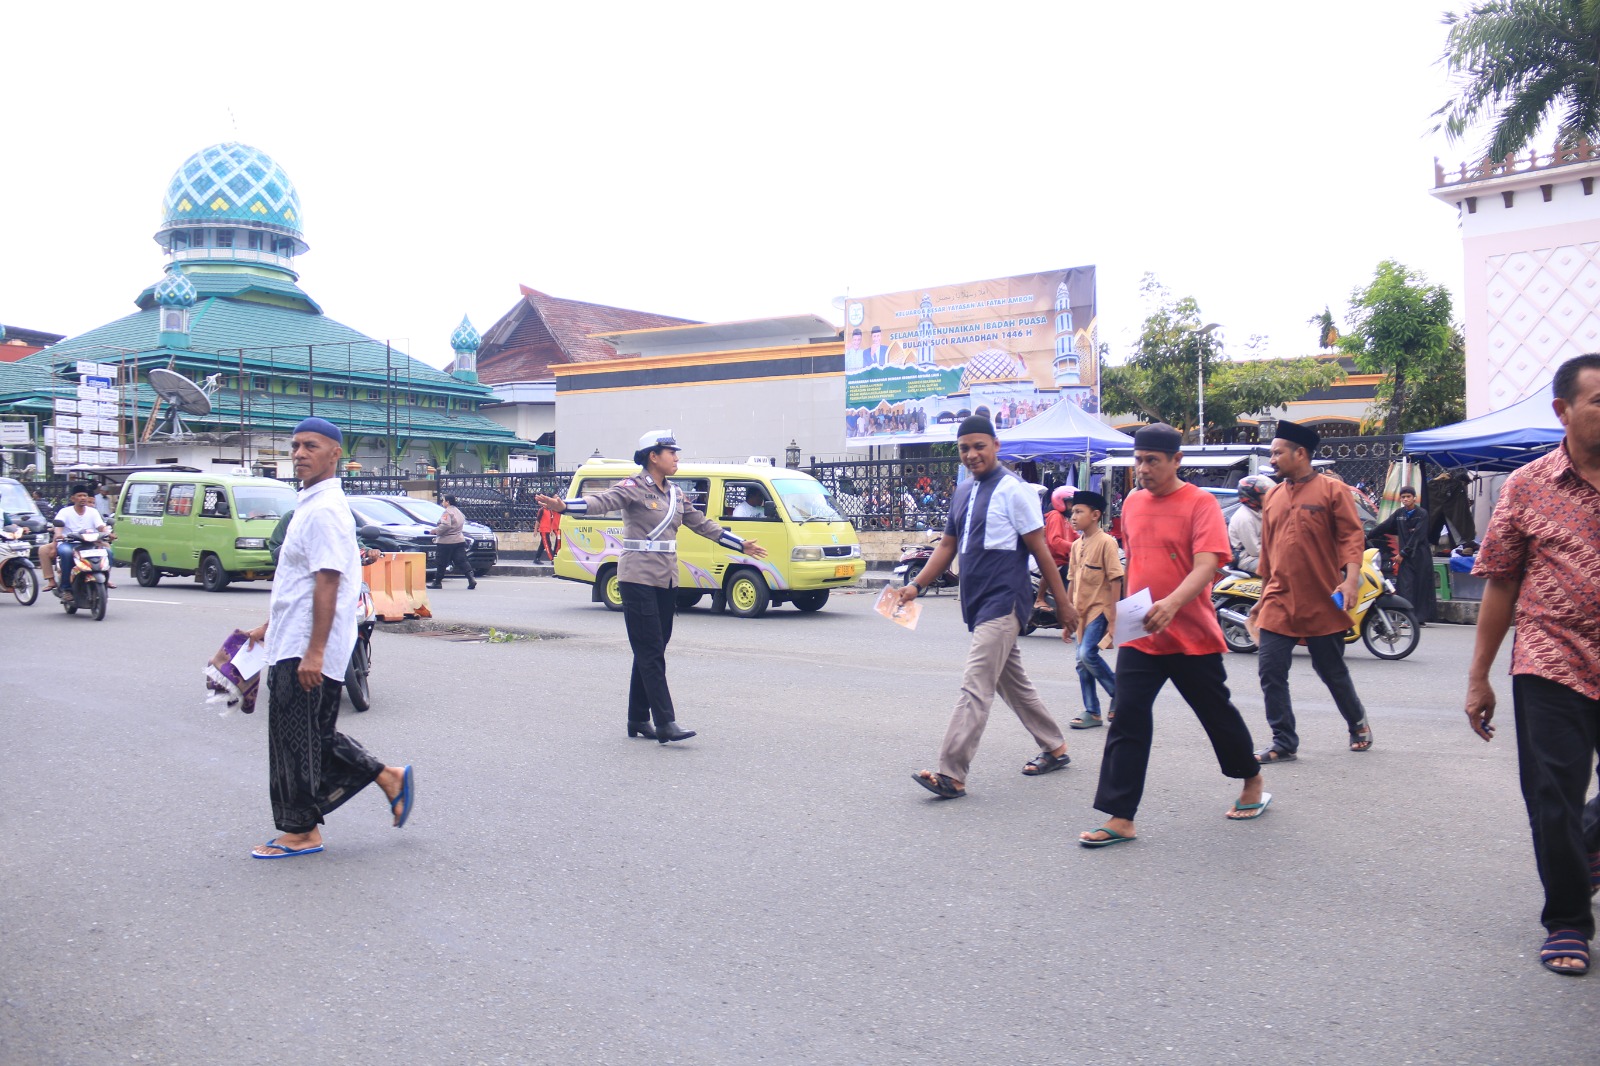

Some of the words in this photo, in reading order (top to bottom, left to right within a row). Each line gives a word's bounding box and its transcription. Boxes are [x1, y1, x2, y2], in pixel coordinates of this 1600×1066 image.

[895, 309, 926, 317] KELUARGA
[927, 305, 946, 313] BESAR
[947, 303, 975, 311] YAYASAN
[986, 298, 1006, 306] FATAH
[1007, 295, 1033, 304] AMBON
[889, 329, 923, 341] SELAMAT
[925, 323, 981, 336] MENUNAIKAN
[983, 320, 1015, 331] IBADAH
[1018, 316, 1047, 327] PUASA
[902, 340, 928, 349] BULAN
[930, 338, 948, 346] SUCI
[950, 332, 998, 345] RAMADHAN
[1001, 329, 1023, 339] 1446
[1026, 329, 1032, 337] H
